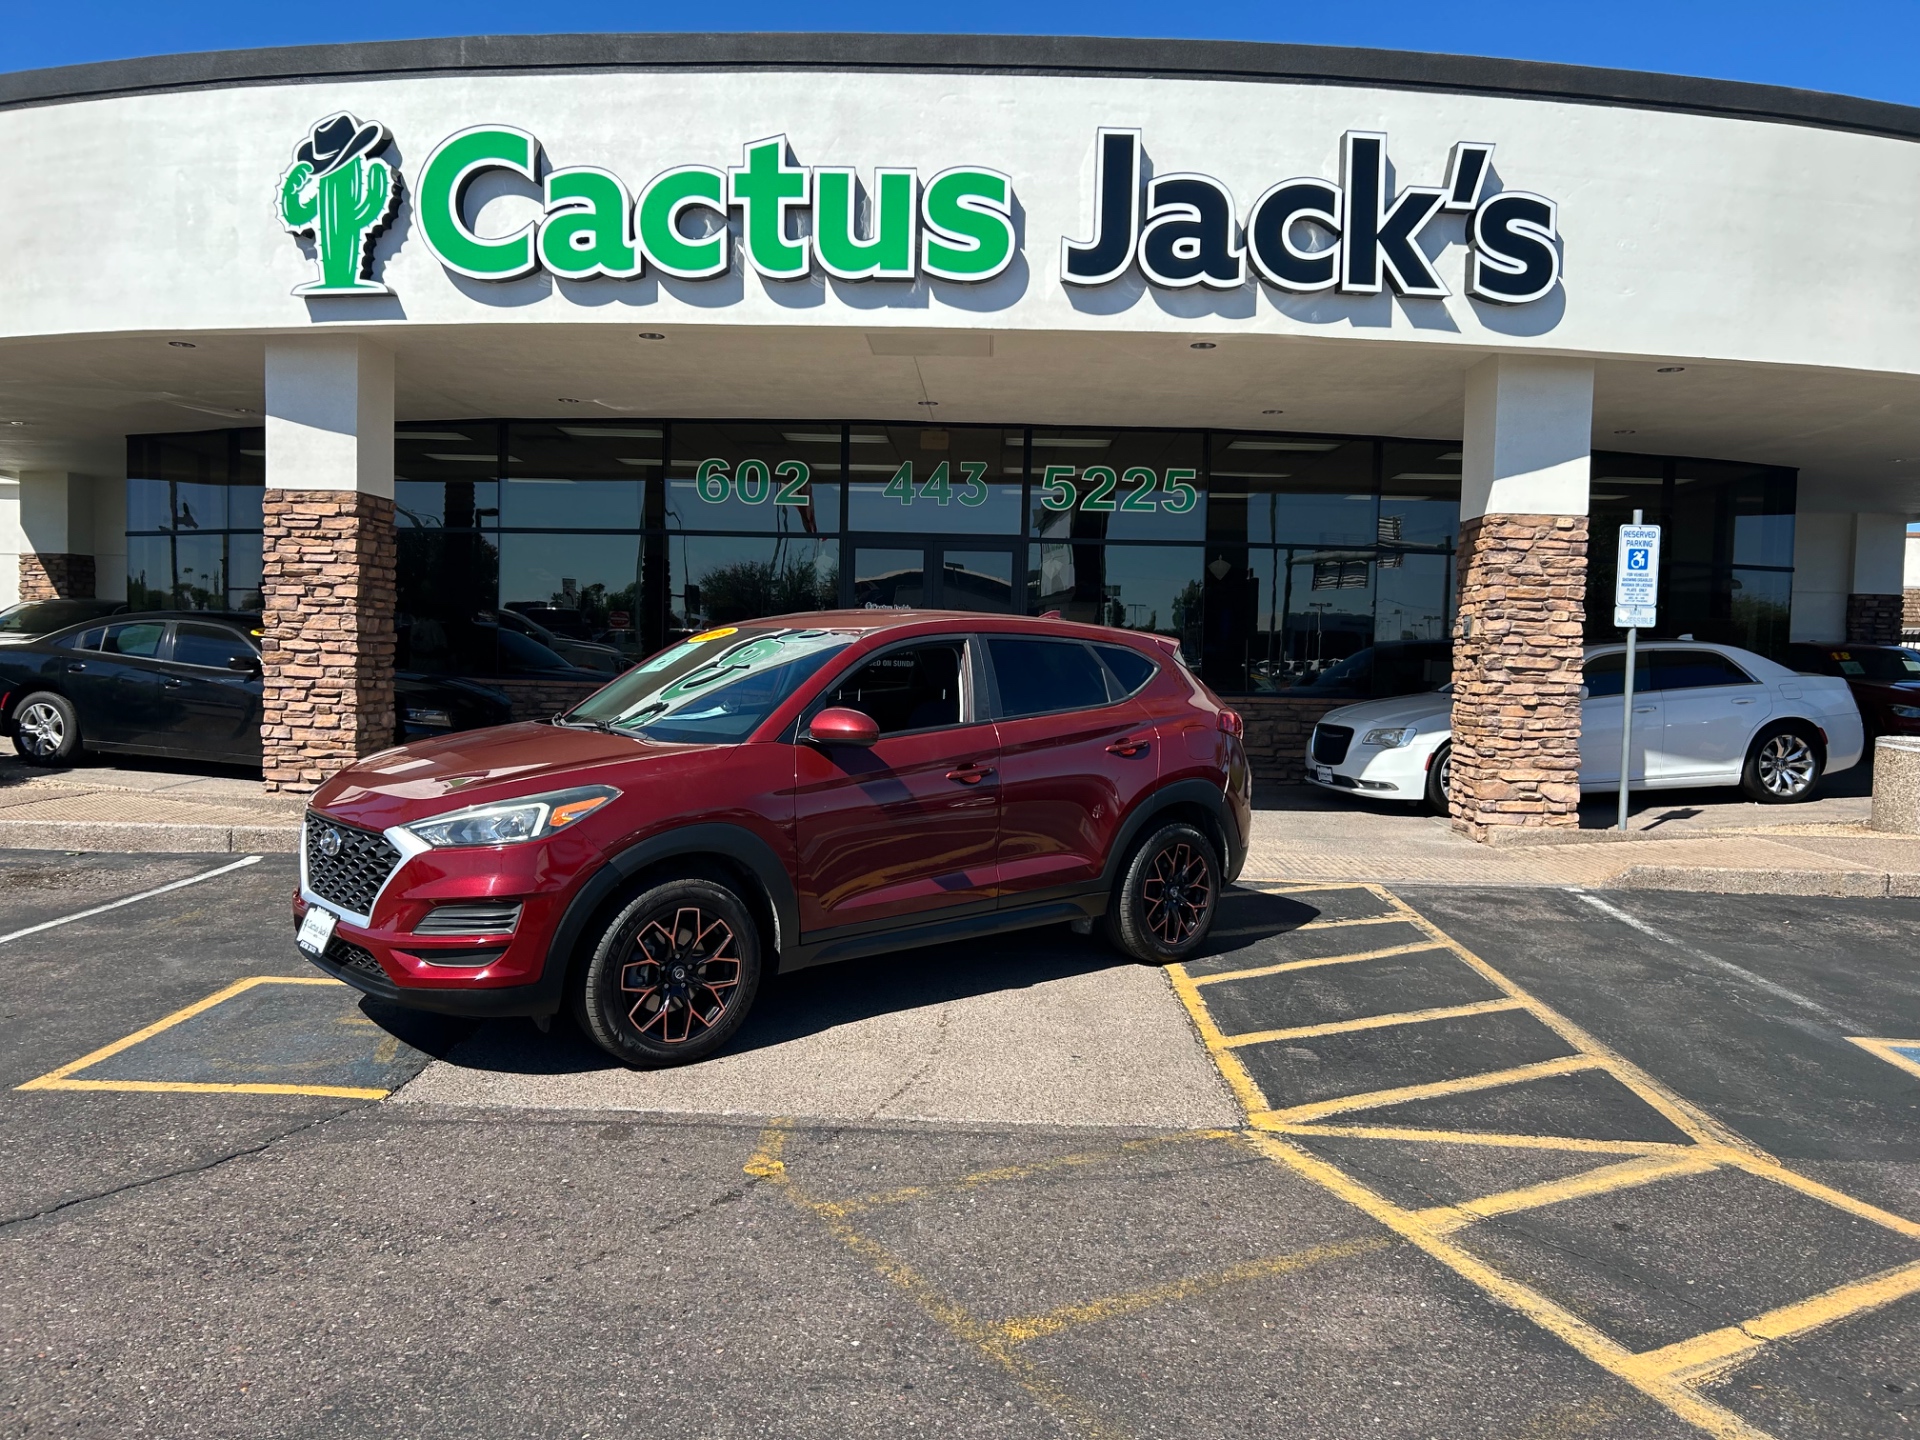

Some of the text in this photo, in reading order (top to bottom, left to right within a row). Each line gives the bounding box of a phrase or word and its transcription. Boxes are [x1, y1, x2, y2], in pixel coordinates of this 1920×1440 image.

[415, 124, 1561, 304] Cactus Jack's
[695, 457, 1198, 514] 602 443 5225
[1623, 530, 1657, 539] RESERVED
[1626, 540, 1653, 548] PARKING
